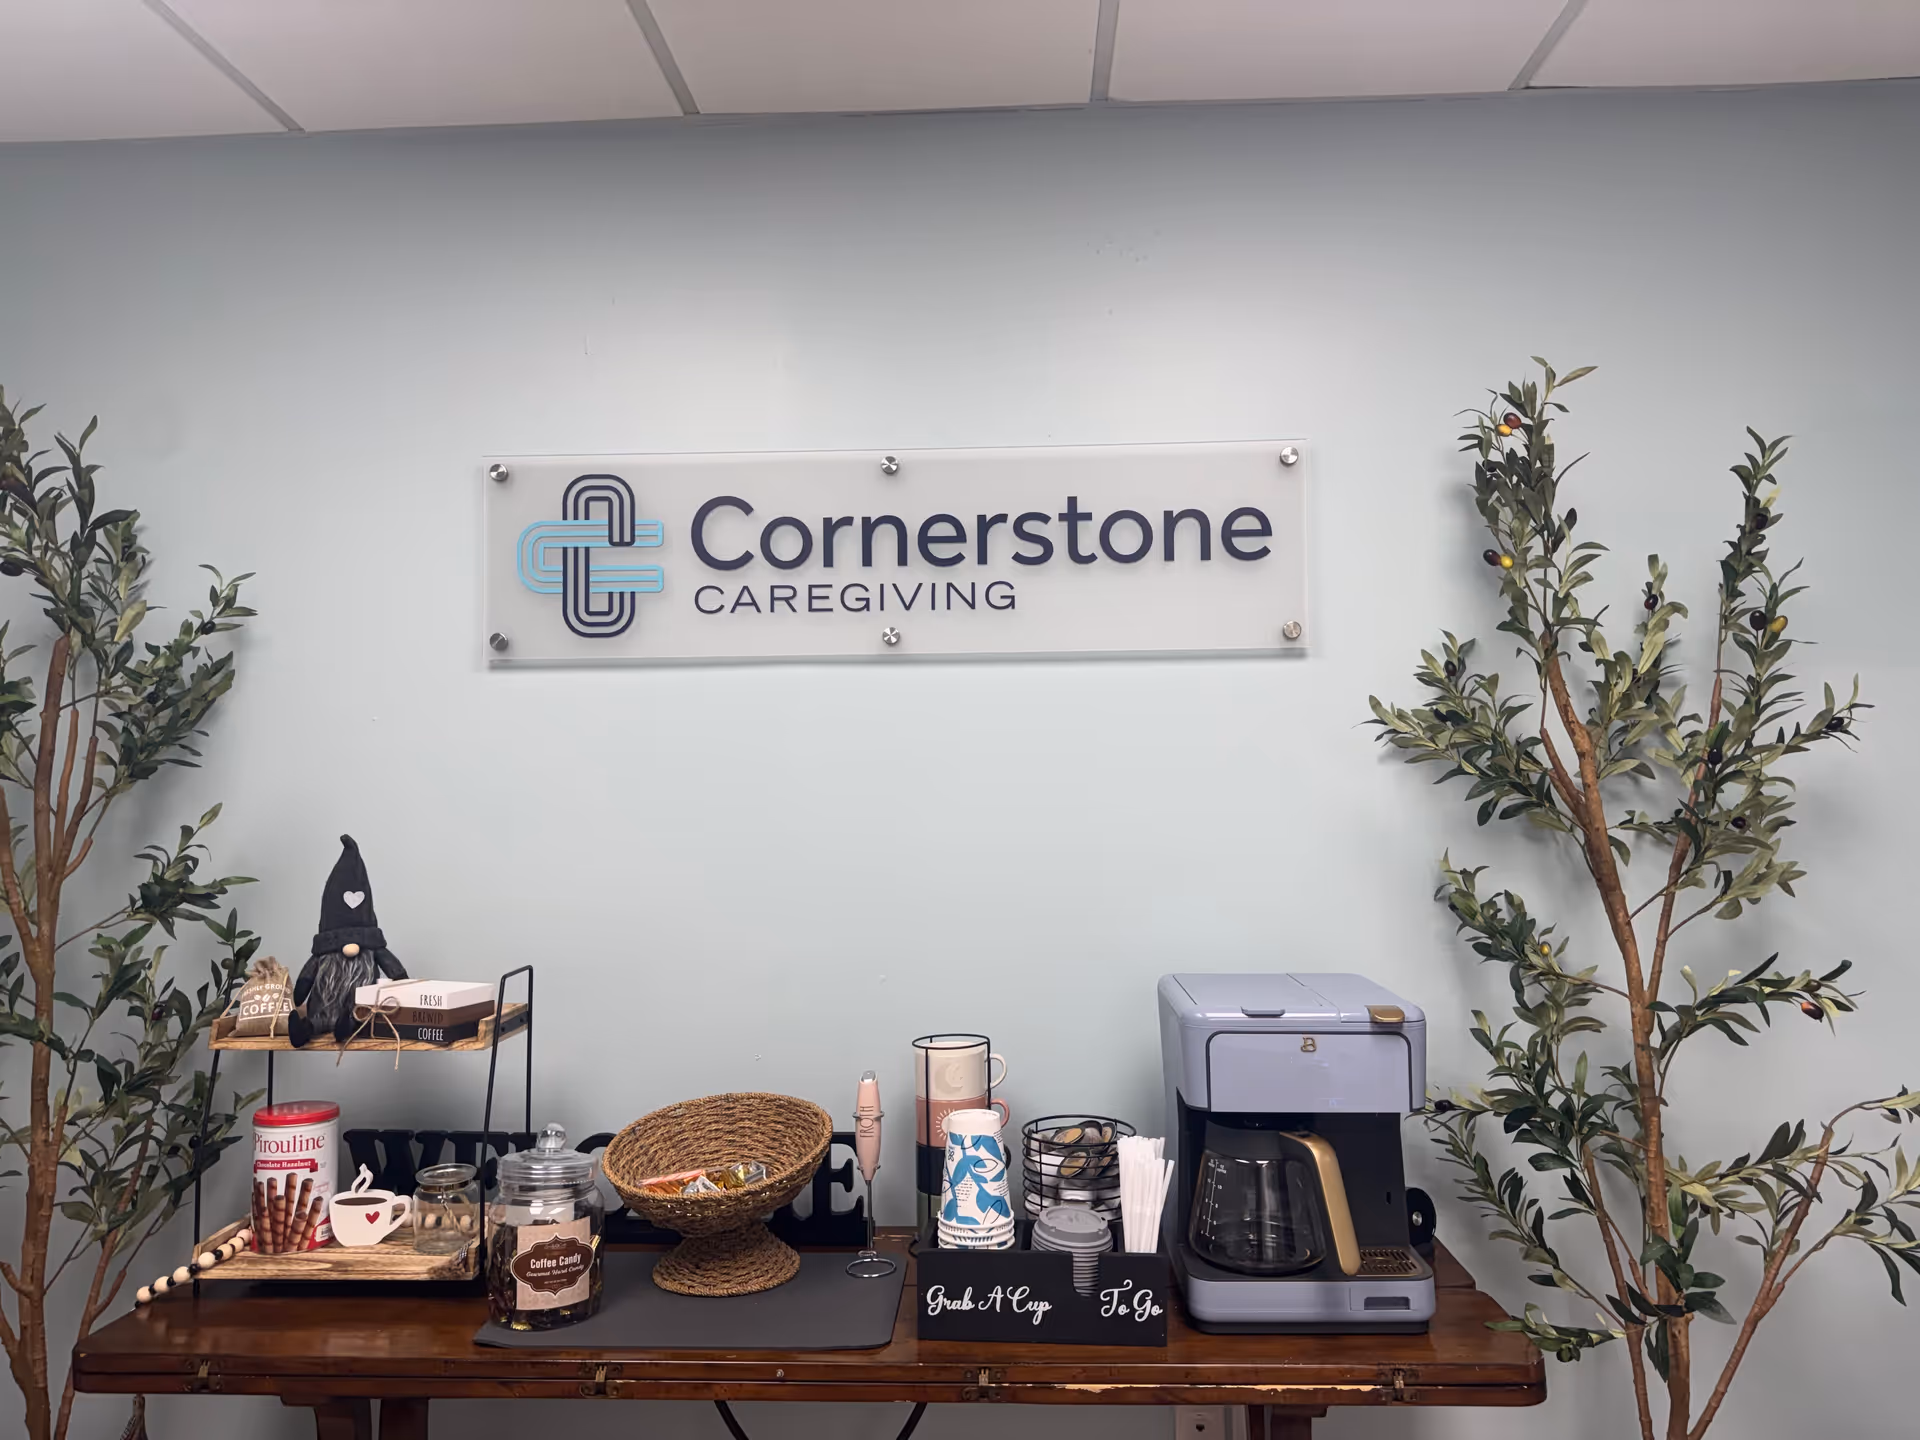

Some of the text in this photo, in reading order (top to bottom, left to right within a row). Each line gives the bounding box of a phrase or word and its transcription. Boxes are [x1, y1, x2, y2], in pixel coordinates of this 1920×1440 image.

[691, 495, 1272, 571] Cornerstone
[694, 580, 1016, 615] CAREGIVING
[420, 994, 443, 1007] FRESH
[417, 1027, 444, 1041] COFFEE
[859, 1105, 874, 1138] FROTH
[252, 1131, 325, 1154] Pirouline
[282, 1160, 312, 1168] Hazelnut
[530, 1252, 582, 1269] Coffee Candy
[926, 1279, 1163, 1325] Grab A Cup To Go
